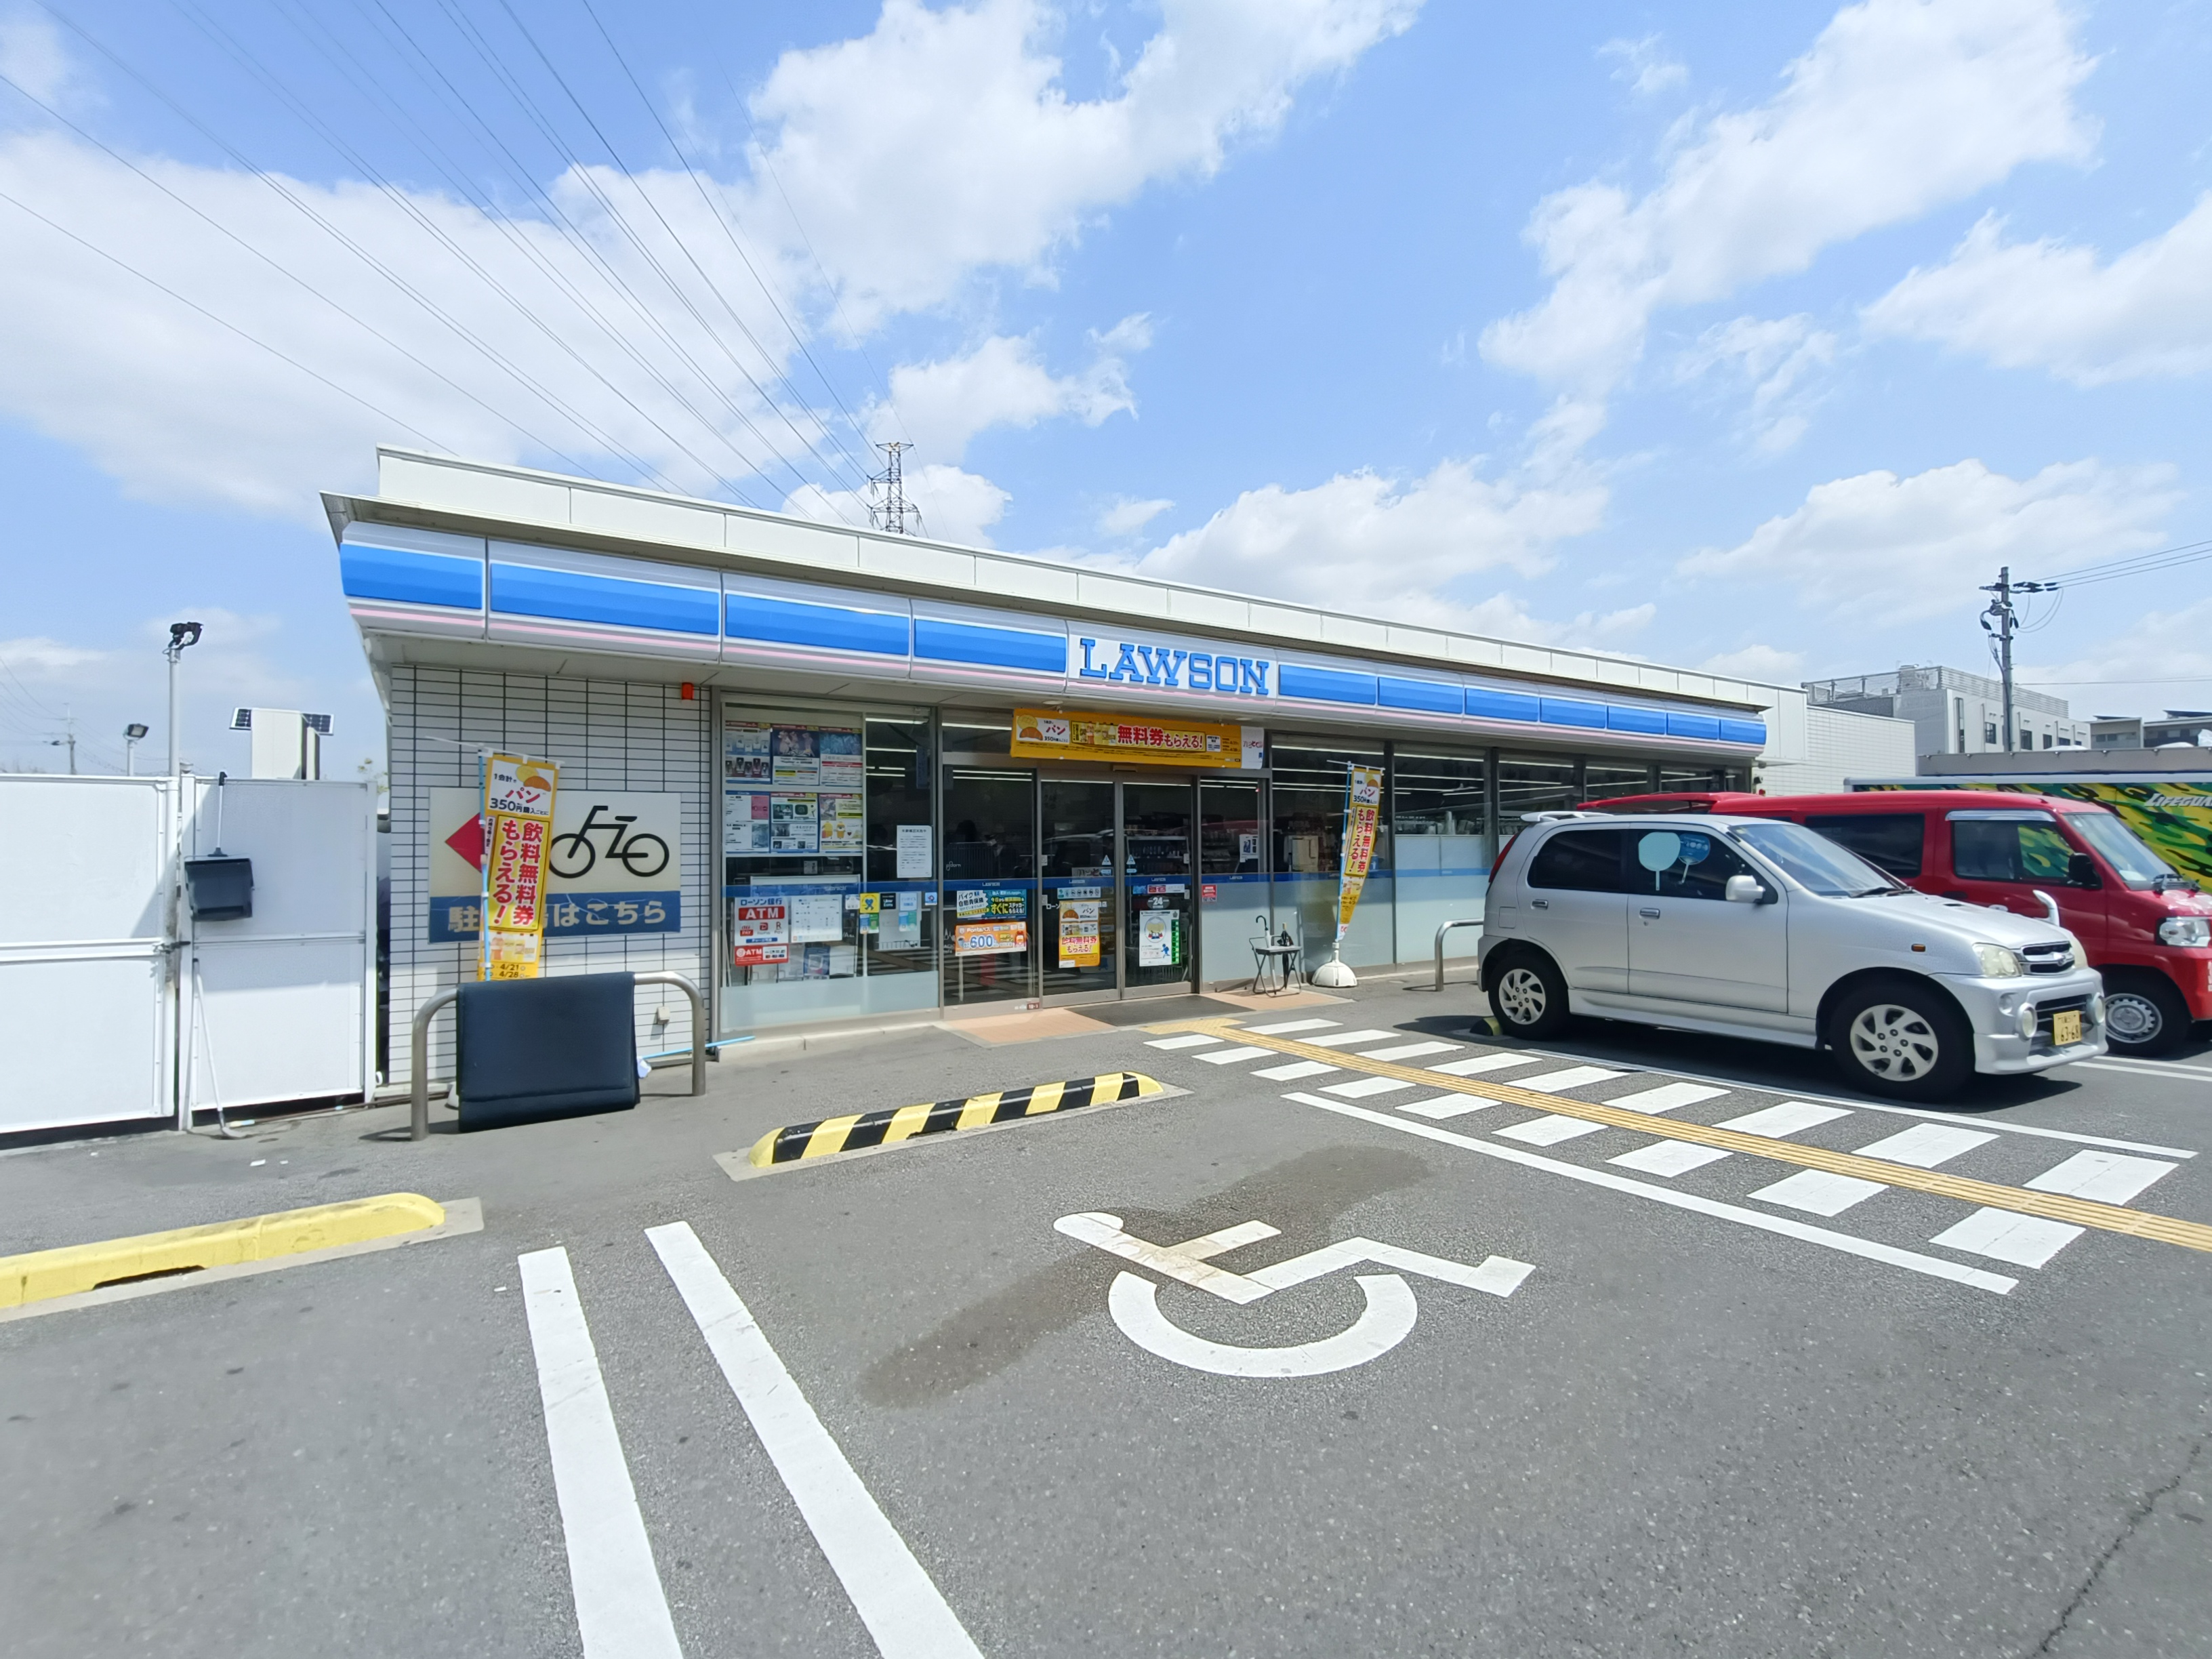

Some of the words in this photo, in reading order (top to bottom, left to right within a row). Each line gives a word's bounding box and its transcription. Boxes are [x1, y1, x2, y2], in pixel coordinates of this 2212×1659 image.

[1080, 638, 1269, 695] LAWSON
[505, 787, 540, 803] パン
[1359, 787, 1375, 797] パン
[1349, 808, 1365, 872] もらえる!
[493, 820, 520, 924] もらえる!
[513, 822, 543, 925] 飲料無料券
[740, 898, 783, 906] ローソン銀行
[745, 907, 779, 920] ATM
[448, 901, 666, 933] 駐はこちら
[970, 935, 994, 948] 600
